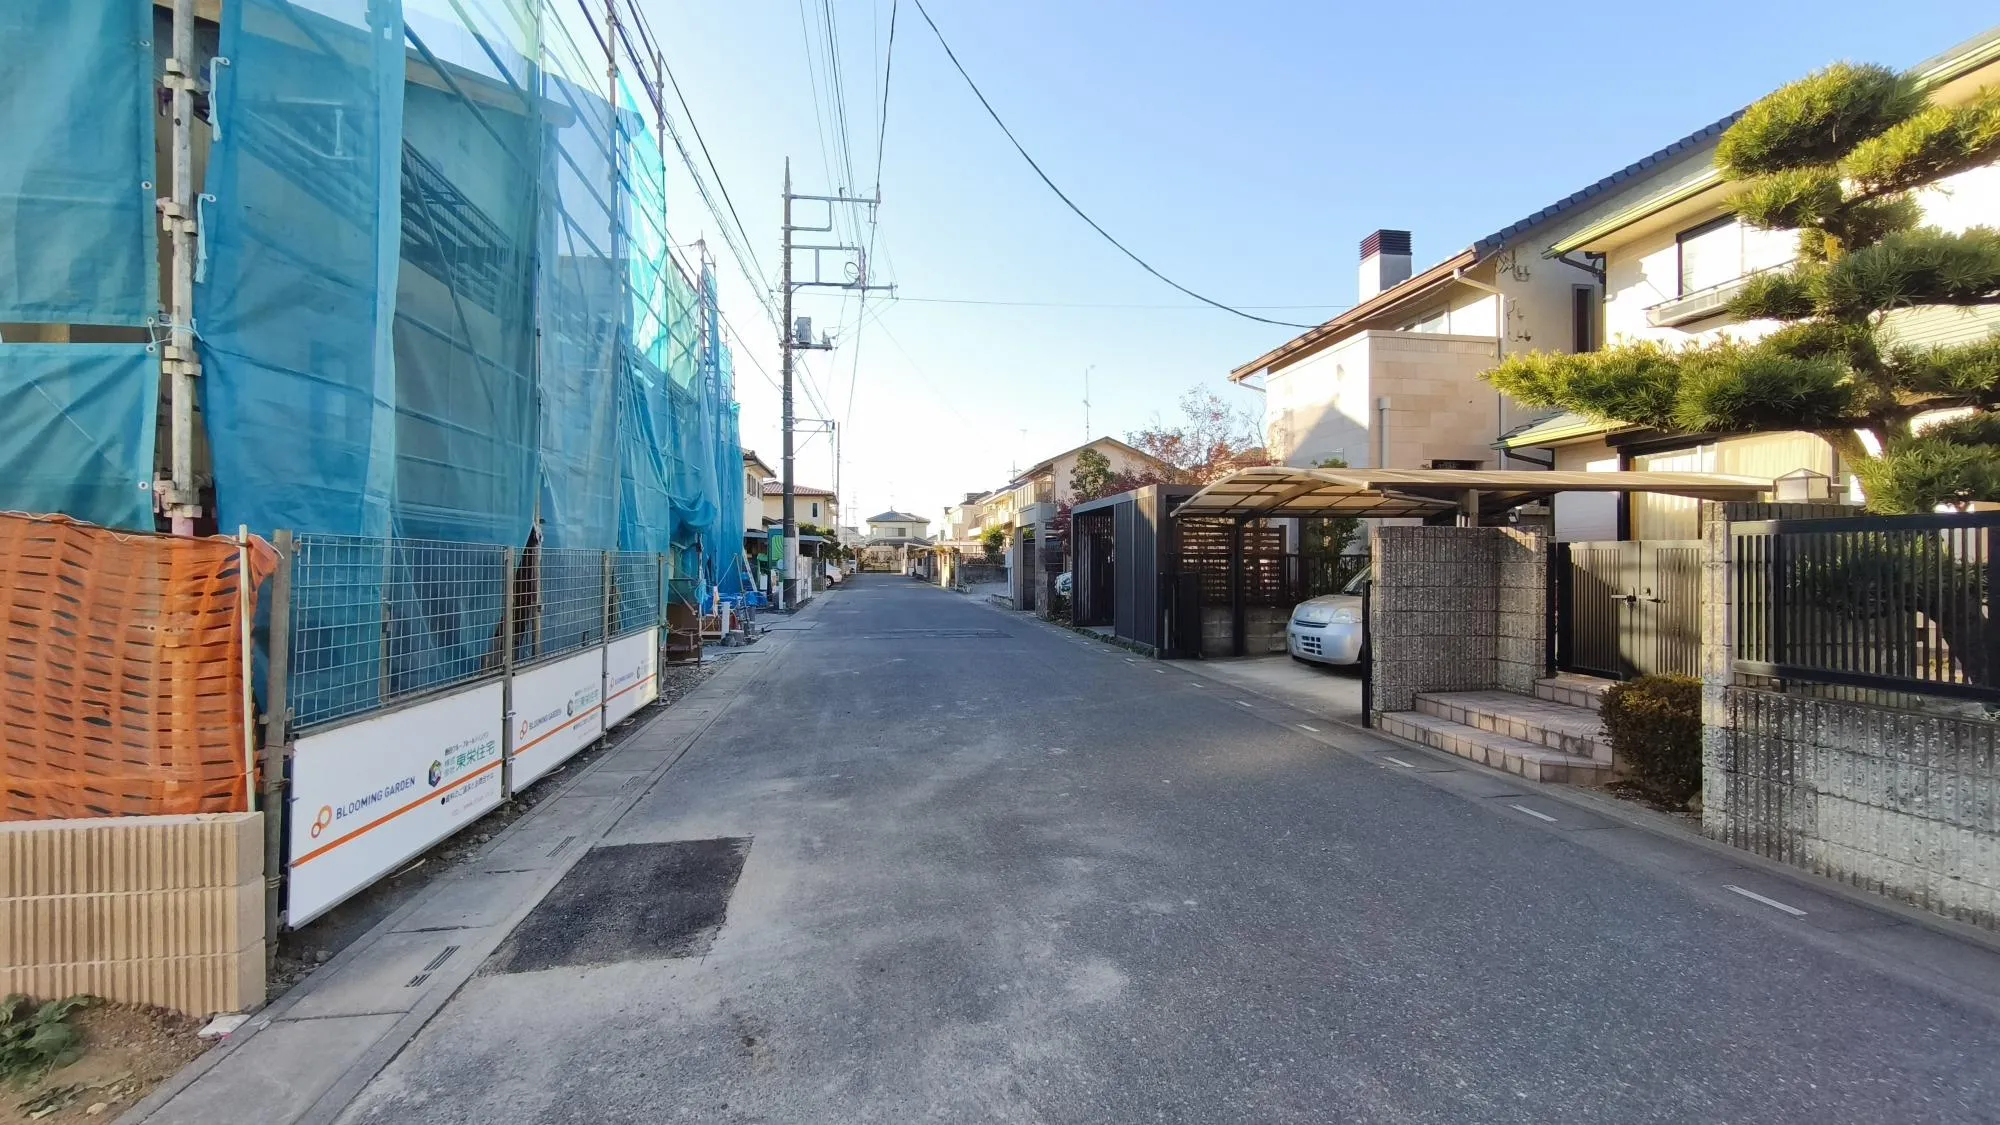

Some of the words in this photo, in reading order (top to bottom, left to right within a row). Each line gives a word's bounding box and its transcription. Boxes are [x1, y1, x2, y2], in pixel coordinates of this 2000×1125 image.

[456, 740, 496, 771] 東栄住宅
[336, 791, 383, 819] BLOOMING
[384, 776, 416, 798] GARDEN
